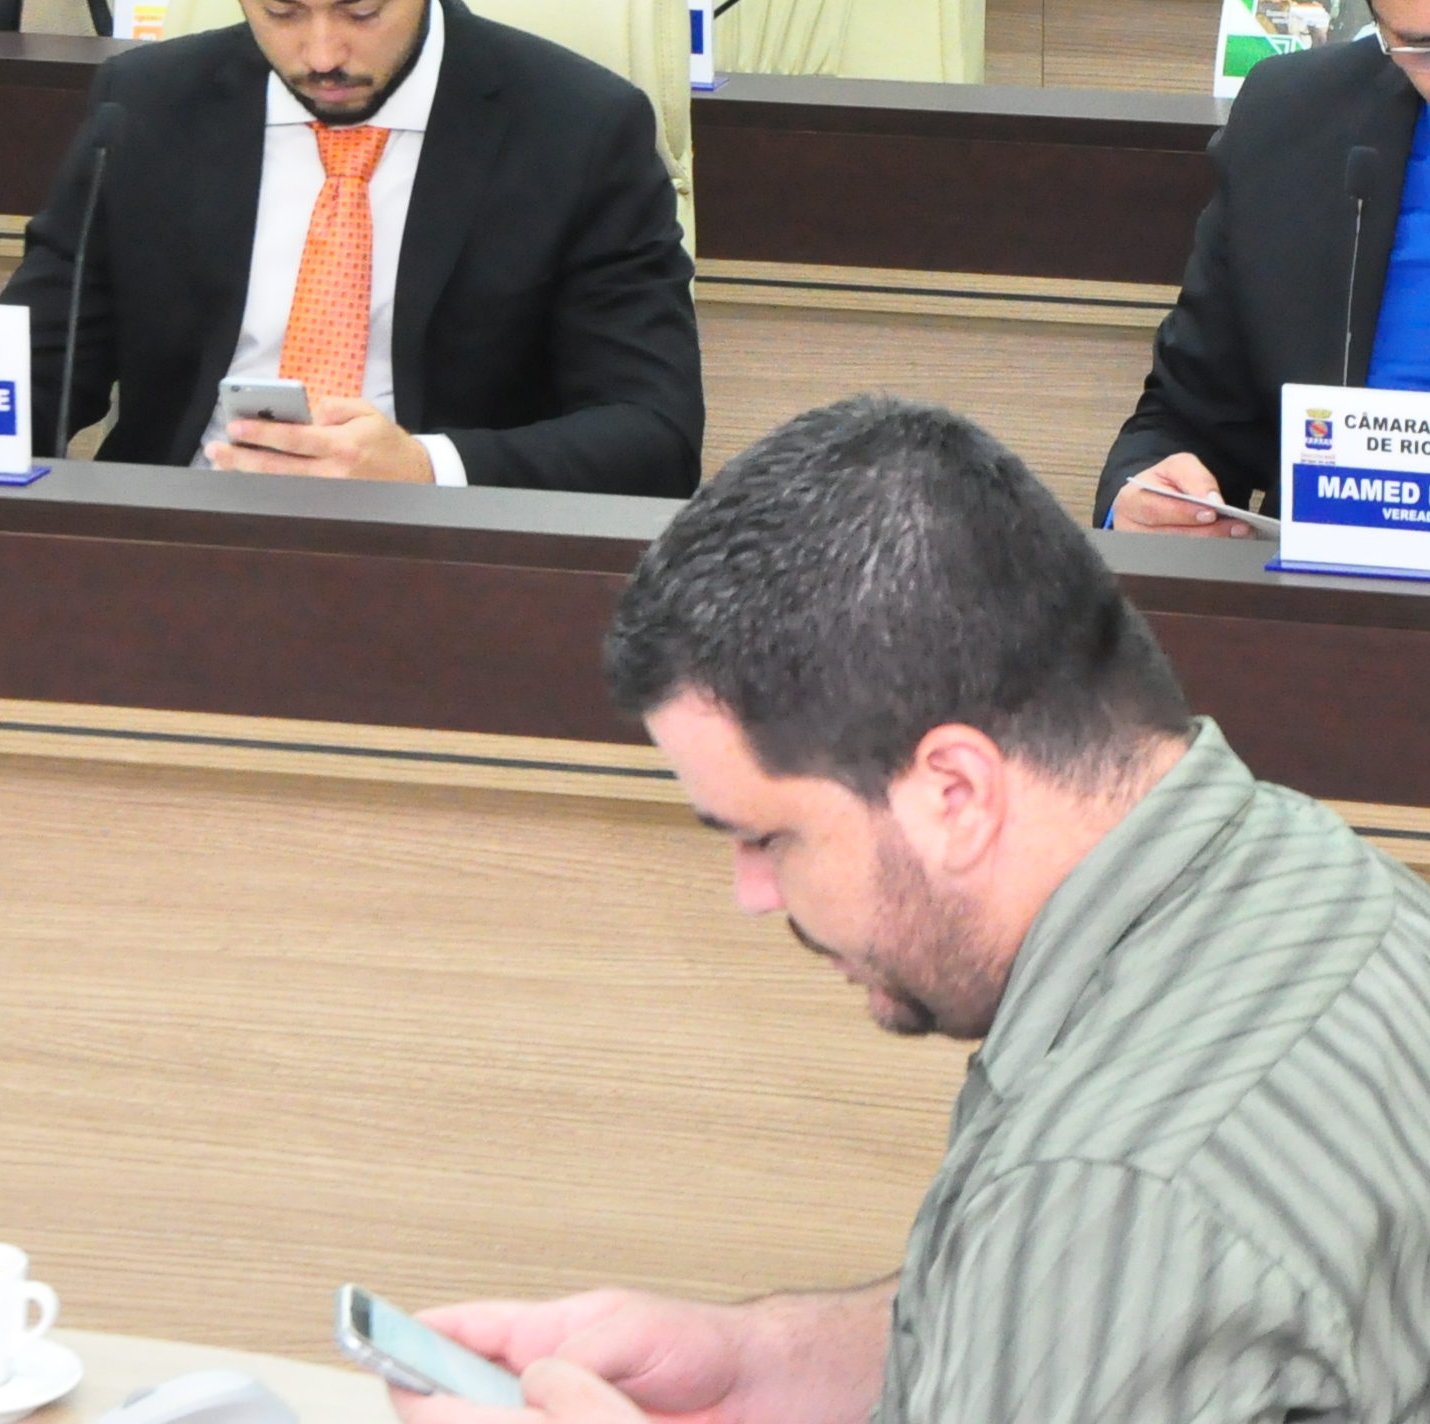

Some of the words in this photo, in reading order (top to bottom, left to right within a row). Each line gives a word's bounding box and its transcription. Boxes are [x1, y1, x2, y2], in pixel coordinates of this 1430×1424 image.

[1344, 412, 1430, 436] CÂMARA
[1366, 436, 1392, 453] DE
[1317, 474, 1421, 505] MAMED
